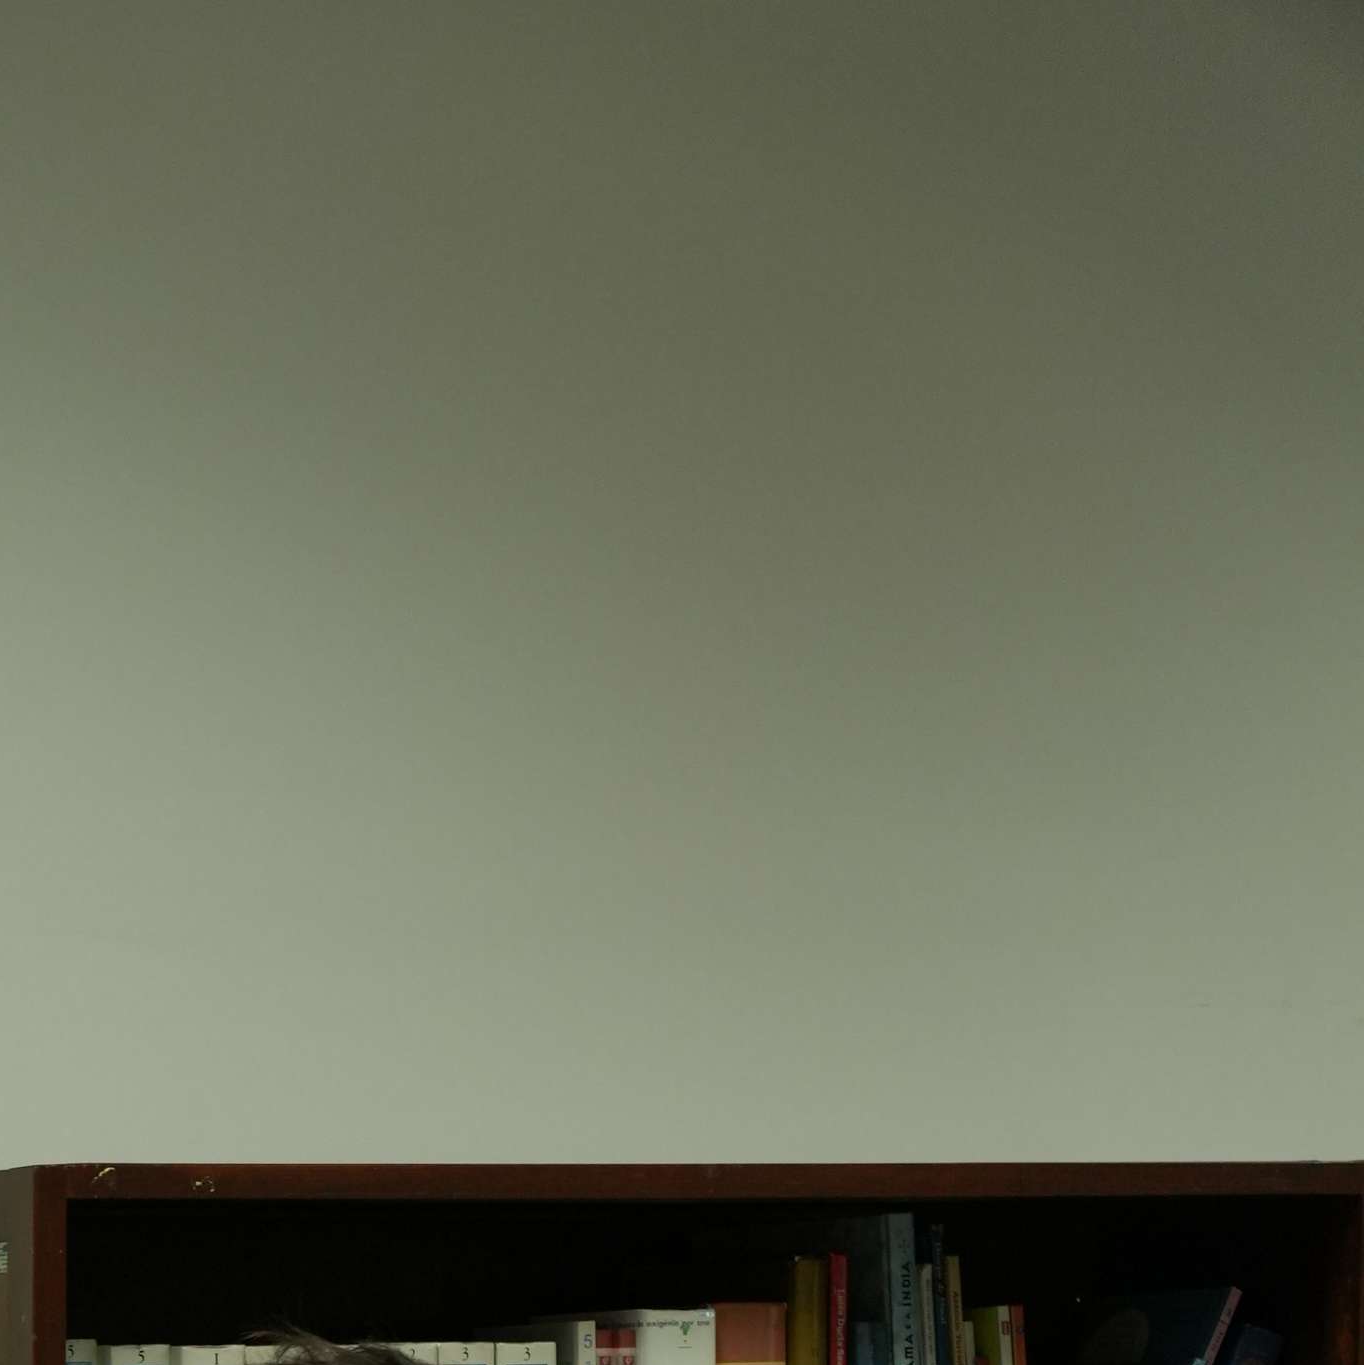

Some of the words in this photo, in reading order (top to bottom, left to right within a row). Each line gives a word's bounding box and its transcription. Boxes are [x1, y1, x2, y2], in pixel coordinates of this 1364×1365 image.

[584, 1335, 593, 1350] 5
[67, 1345, 75, 1359] 5
[138, 1350, 145, 1363] 5
[463, 1347, 470, 1361] 3
[525, 1347, 532, 1361] 3
